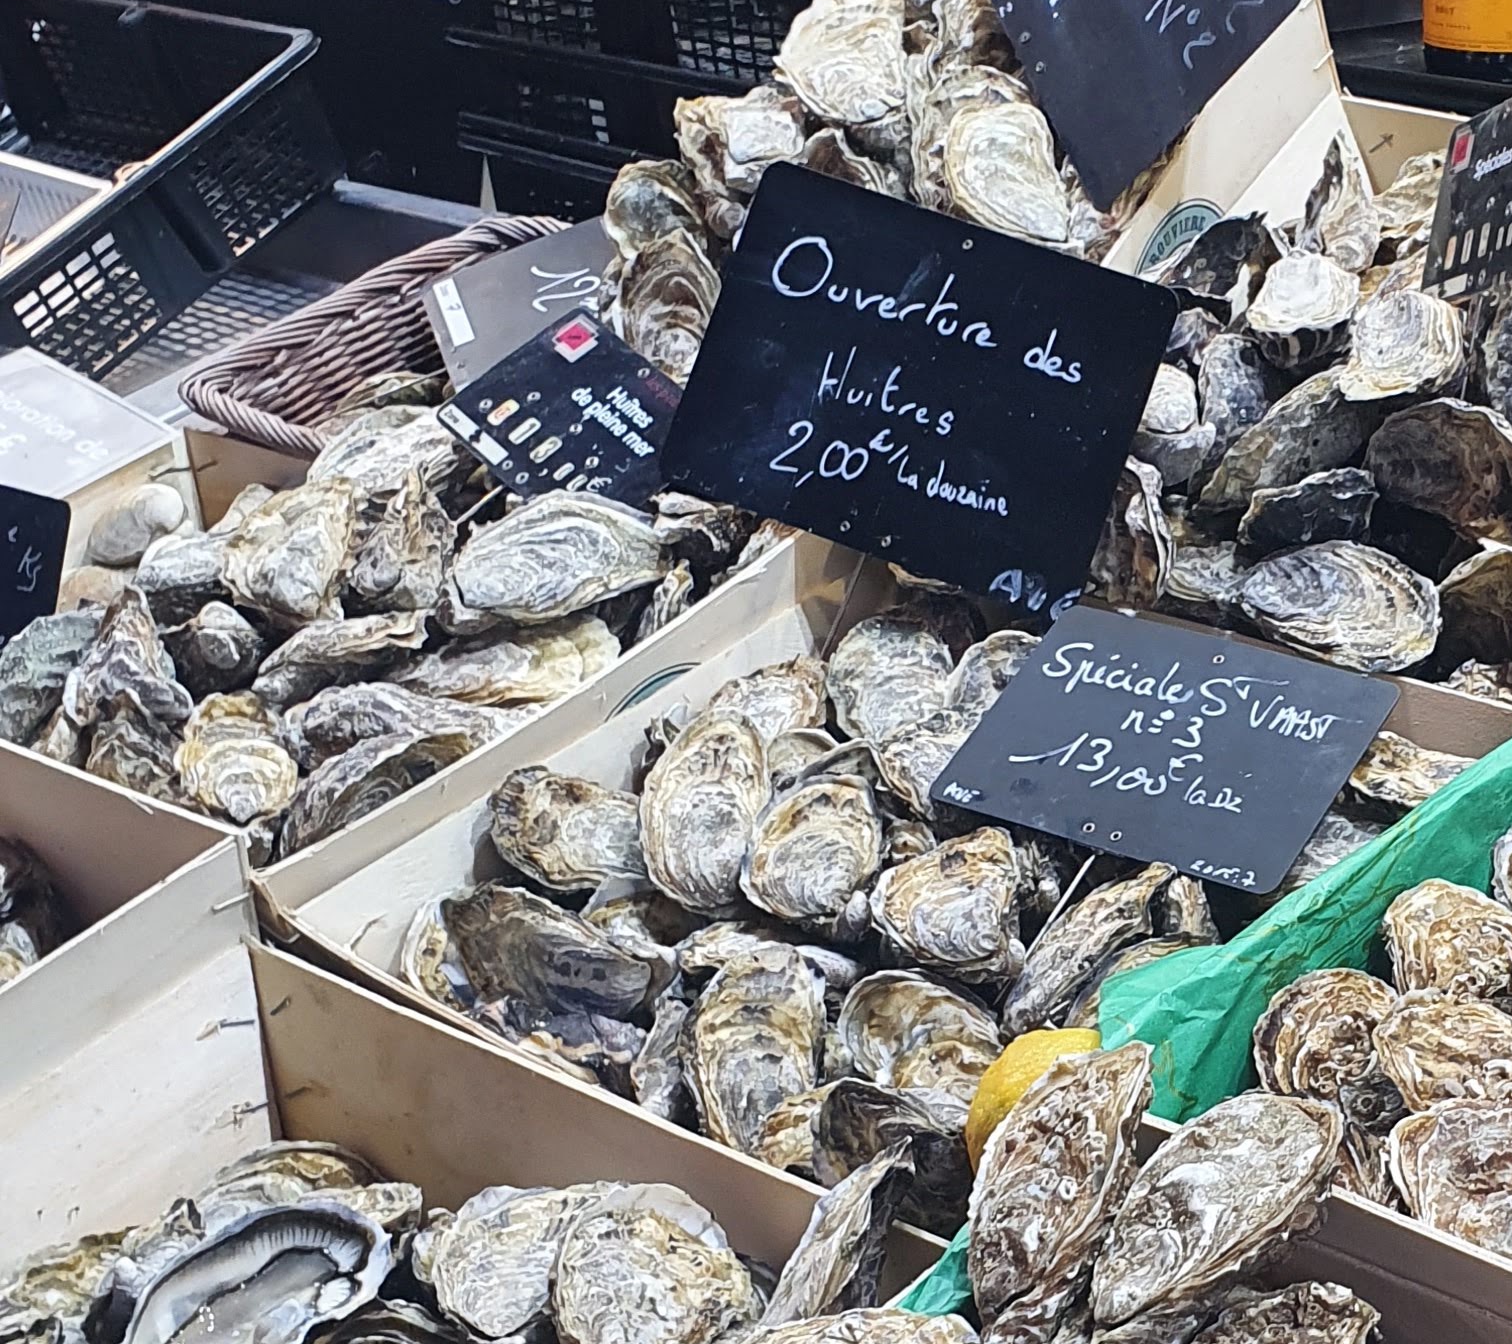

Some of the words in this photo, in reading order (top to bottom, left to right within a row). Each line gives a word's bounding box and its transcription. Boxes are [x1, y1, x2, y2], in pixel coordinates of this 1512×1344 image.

[771, 234, 998, 349] Ouverture
[1023, 329, 1084, 385] des
[570, 386, 592, 407] de
[583, 395, 623, 434] pleine
[621, 429, 656, 458] mer
[925, 461, 1010, 518] douzaine
